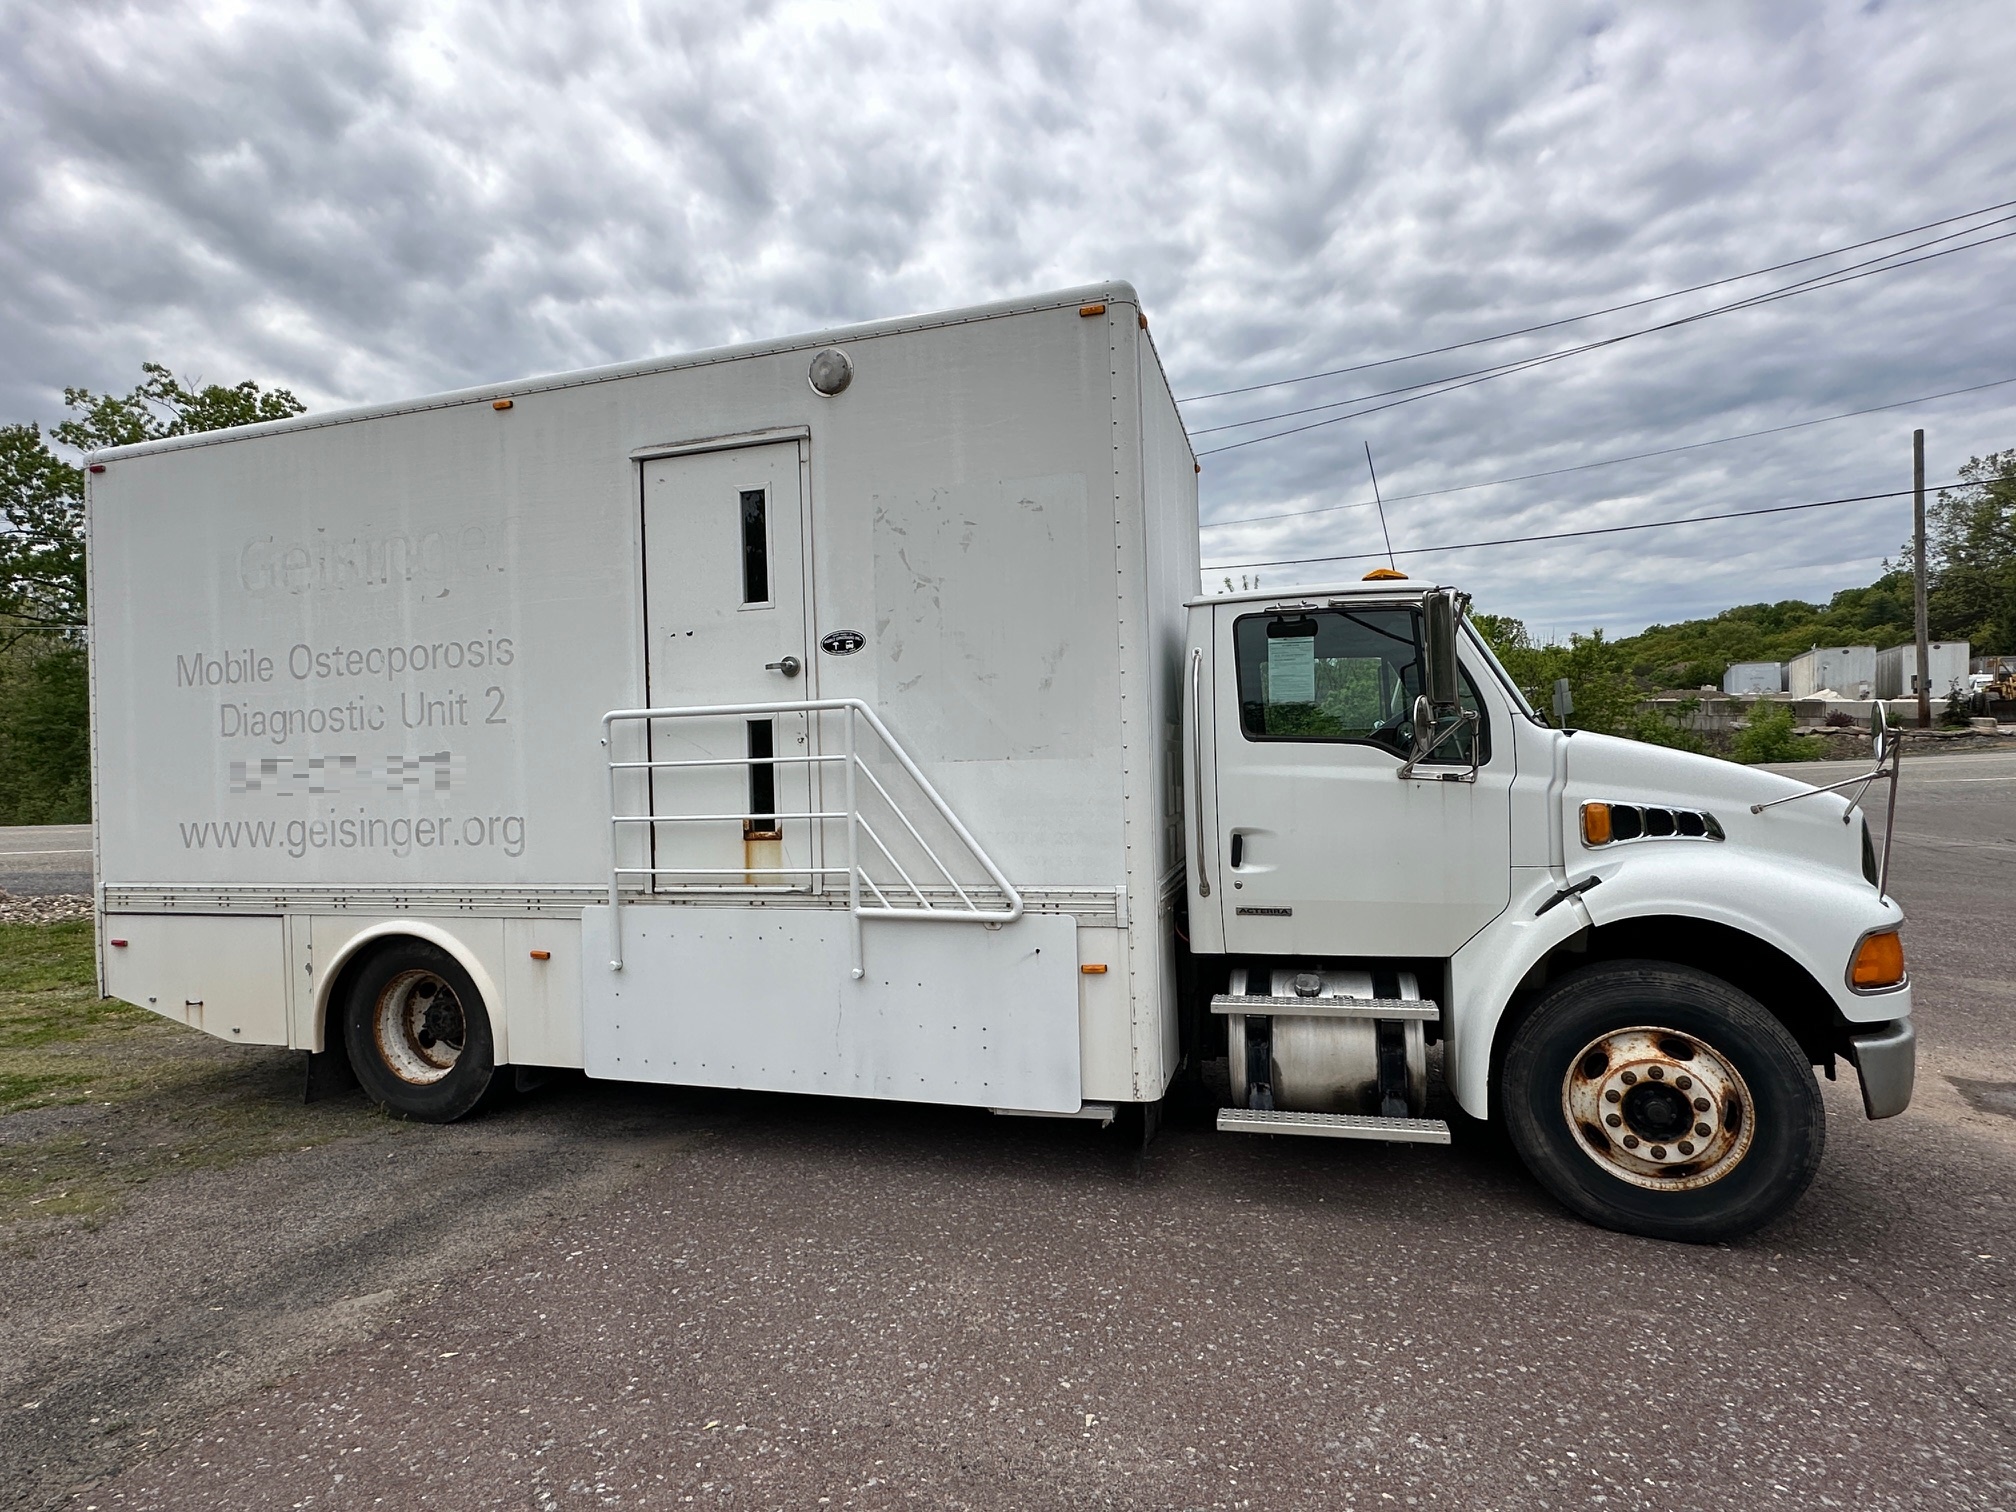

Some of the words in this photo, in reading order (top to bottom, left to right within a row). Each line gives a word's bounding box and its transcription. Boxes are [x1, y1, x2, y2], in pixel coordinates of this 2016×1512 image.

[176, 648, 275, 688] Mobile
[288, 628, 515, 682] Osteoporosis
[220, 694, 386, 745] Diagnostic
[400, 689, 469, 729] Unit
[484, 686, 508, 725] 2
[179, 807, 526, 859] www.geisinger.org
